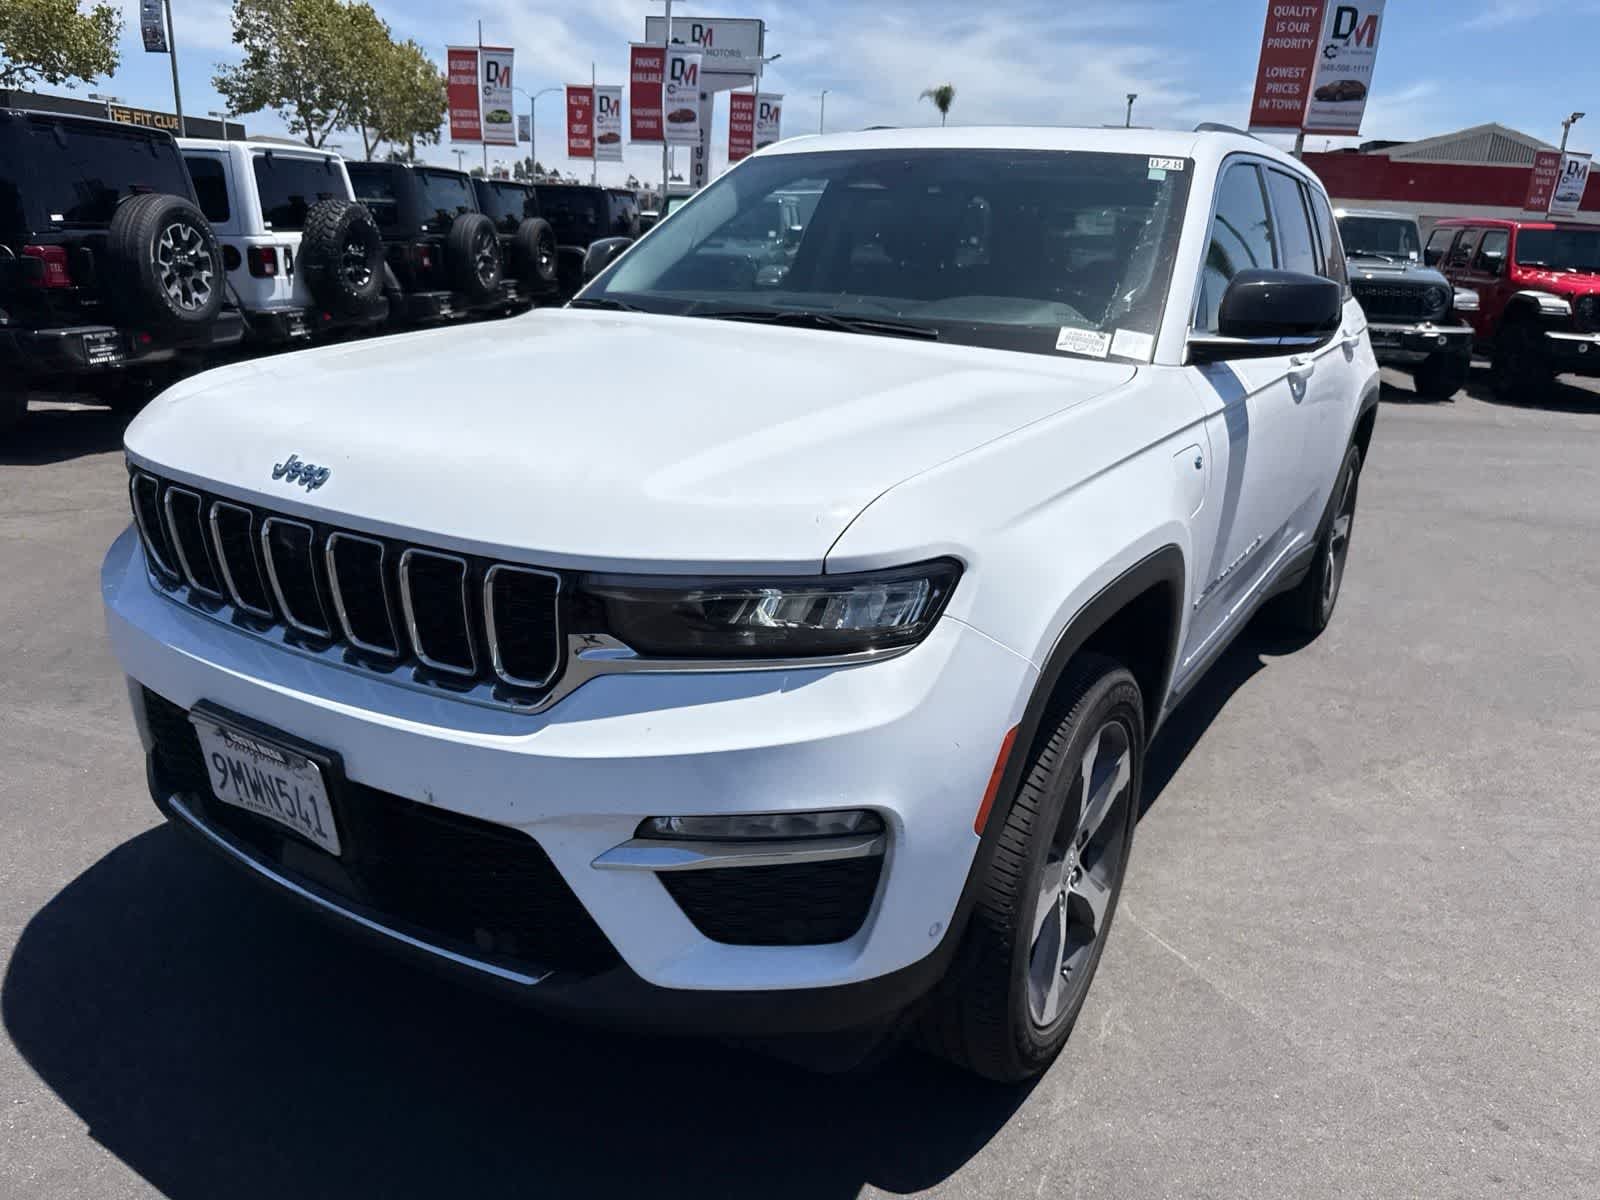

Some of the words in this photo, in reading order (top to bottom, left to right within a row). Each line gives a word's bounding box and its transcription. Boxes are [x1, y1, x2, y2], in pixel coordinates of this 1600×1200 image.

[1273, 6, 1317, 17] QUALITY
[1276, 22, 1286, 32] IS
[1287, 22, 1310, 32] OUR
[1267, 38, 1314, 49] PRIORITY
[1266, 67, 1306, 78] LOWEST
[1266, 82, 1300, 94] PRICES
[1258, 99, 1270, 108] IN
[1270, 99, 1302, 110] TOWN
[111, 109, 131, 123] HE
[133, 111, 152, 125] FIT
[272, 454, 329, 493] Jeep
[211, 752, 329, 839] 9MWN541
